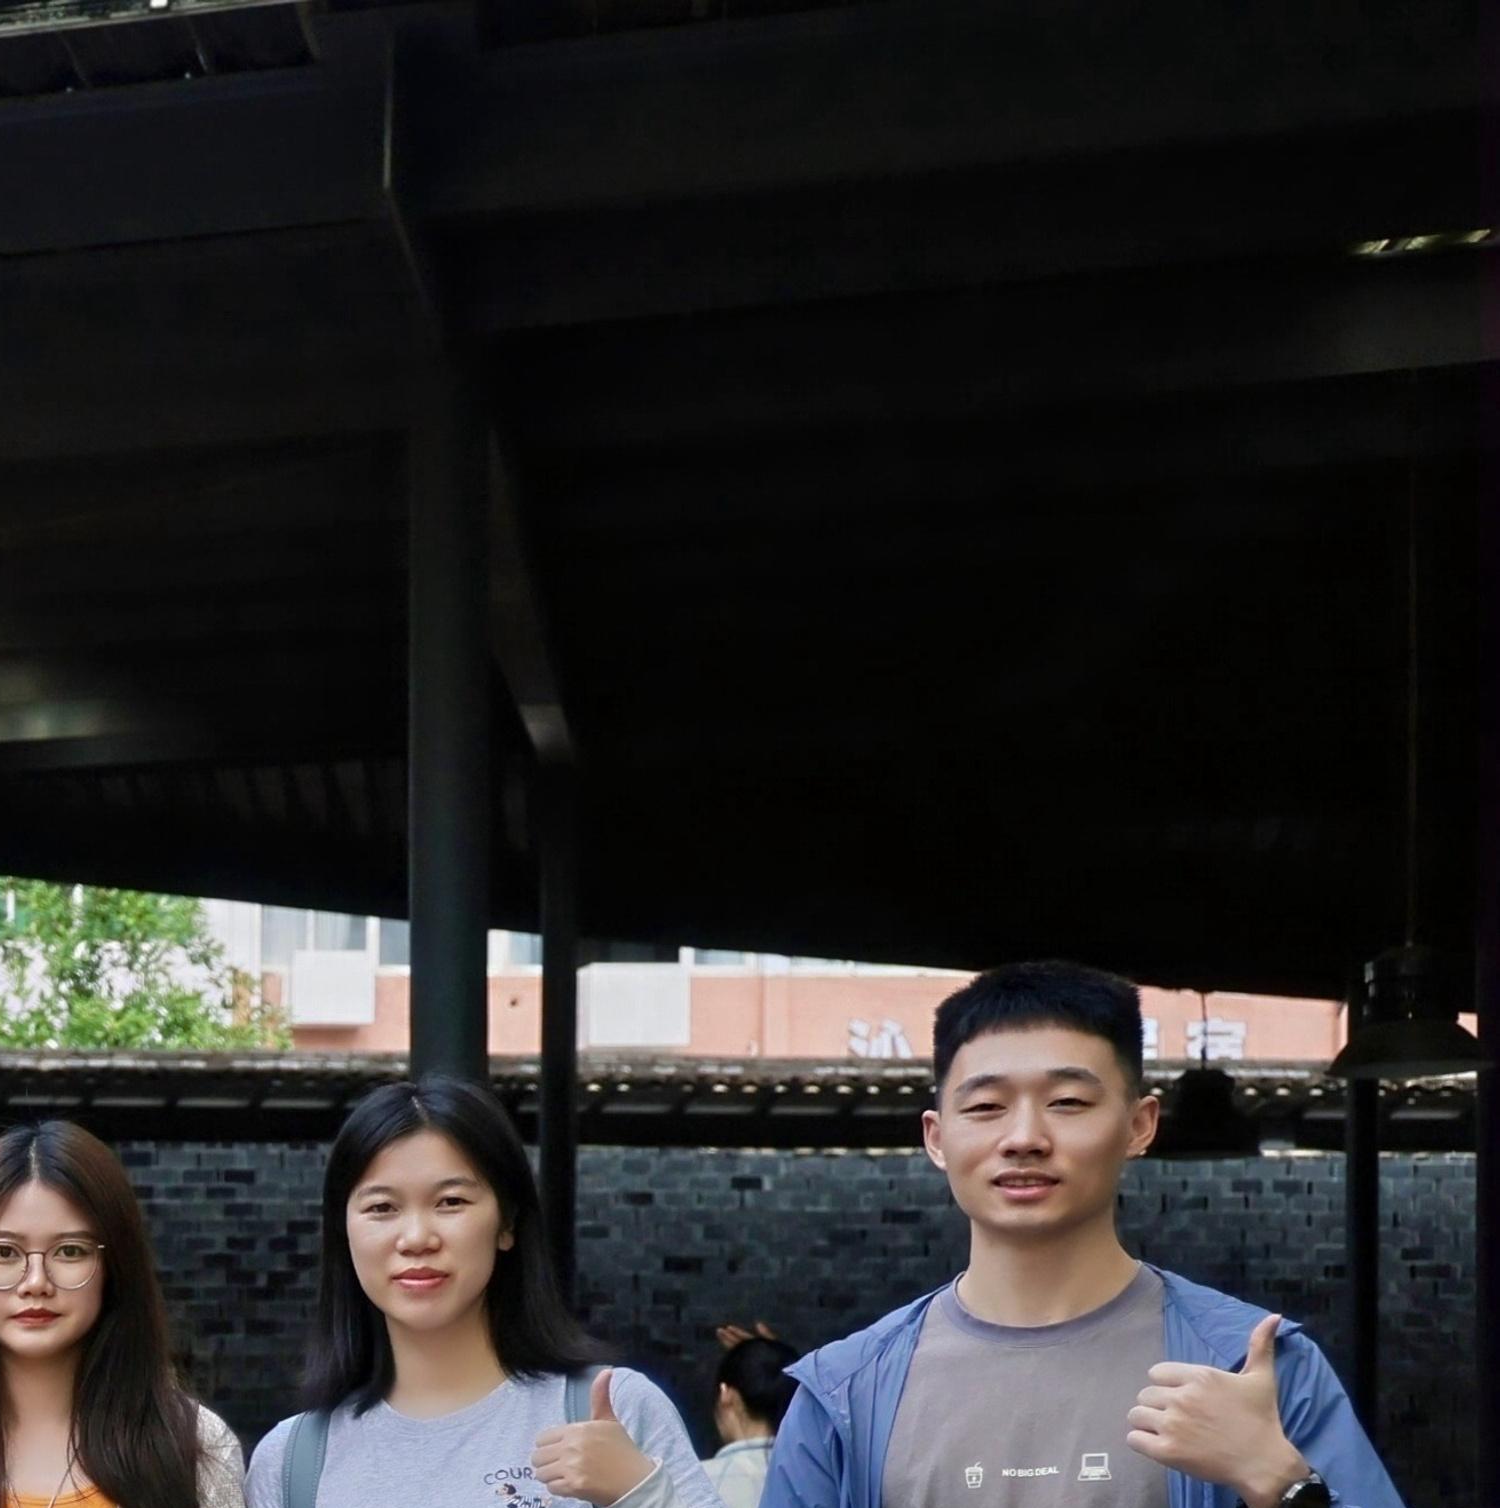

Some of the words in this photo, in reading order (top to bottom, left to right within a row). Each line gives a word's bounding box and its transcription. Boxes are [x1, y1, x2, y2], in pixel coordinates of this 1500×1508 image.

[483, 1467, 536, 1485] COUR
[1001, 1468, 1017, 1477] NO
[1018, 1468, 1034, 1477] BIG
[1035, 1466, 1060, 1477] DEAL
